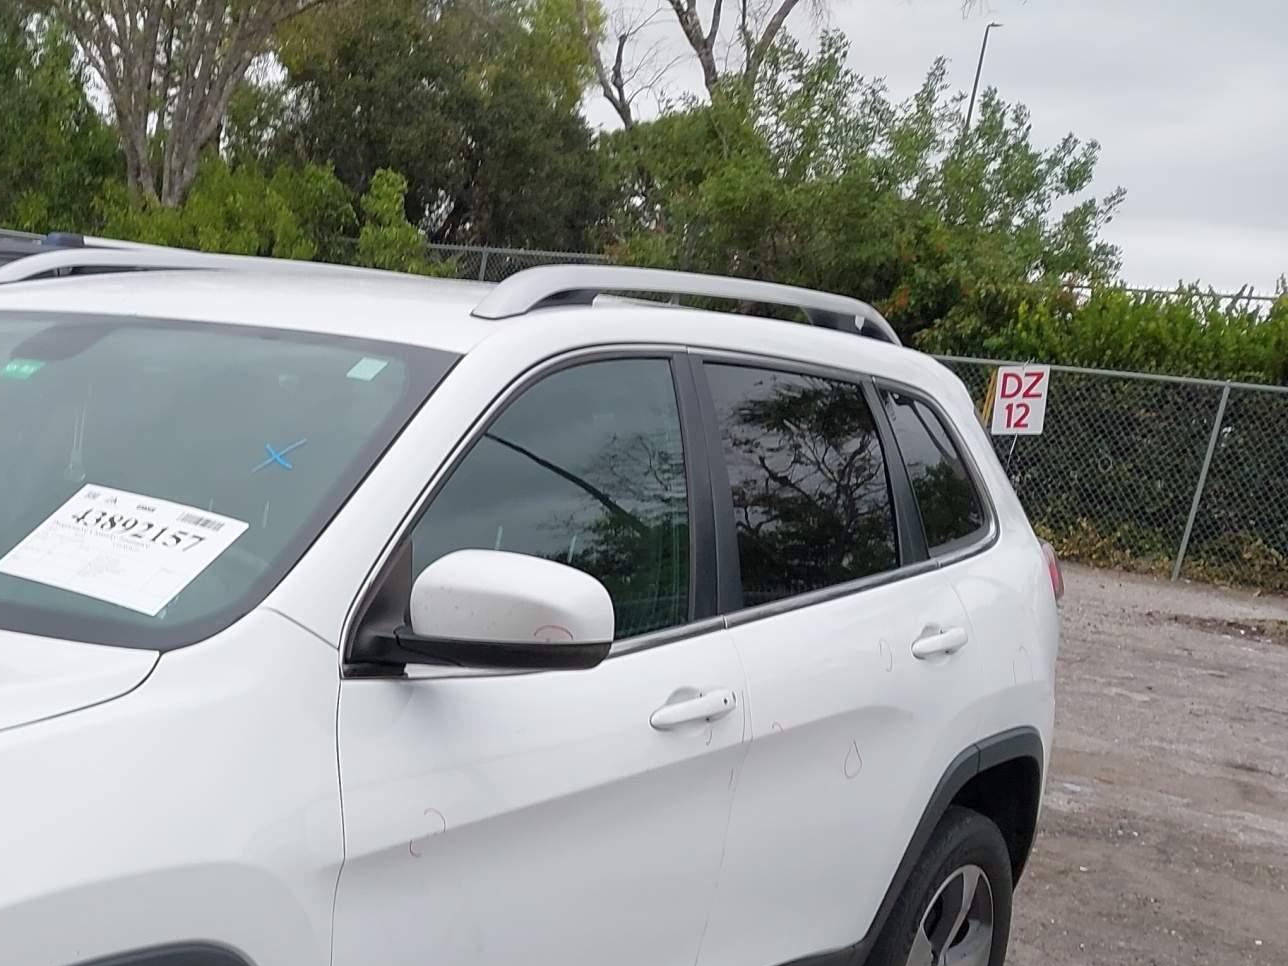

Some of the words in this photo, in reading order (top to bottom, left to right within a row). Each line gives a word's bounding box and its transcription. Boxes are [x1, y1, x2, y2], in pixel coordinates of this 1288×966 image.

[1000, 371, 1044, 399] DZ
[1005, 402, 1030, 429] 12
[72, 508, 206, 552] 43892157
